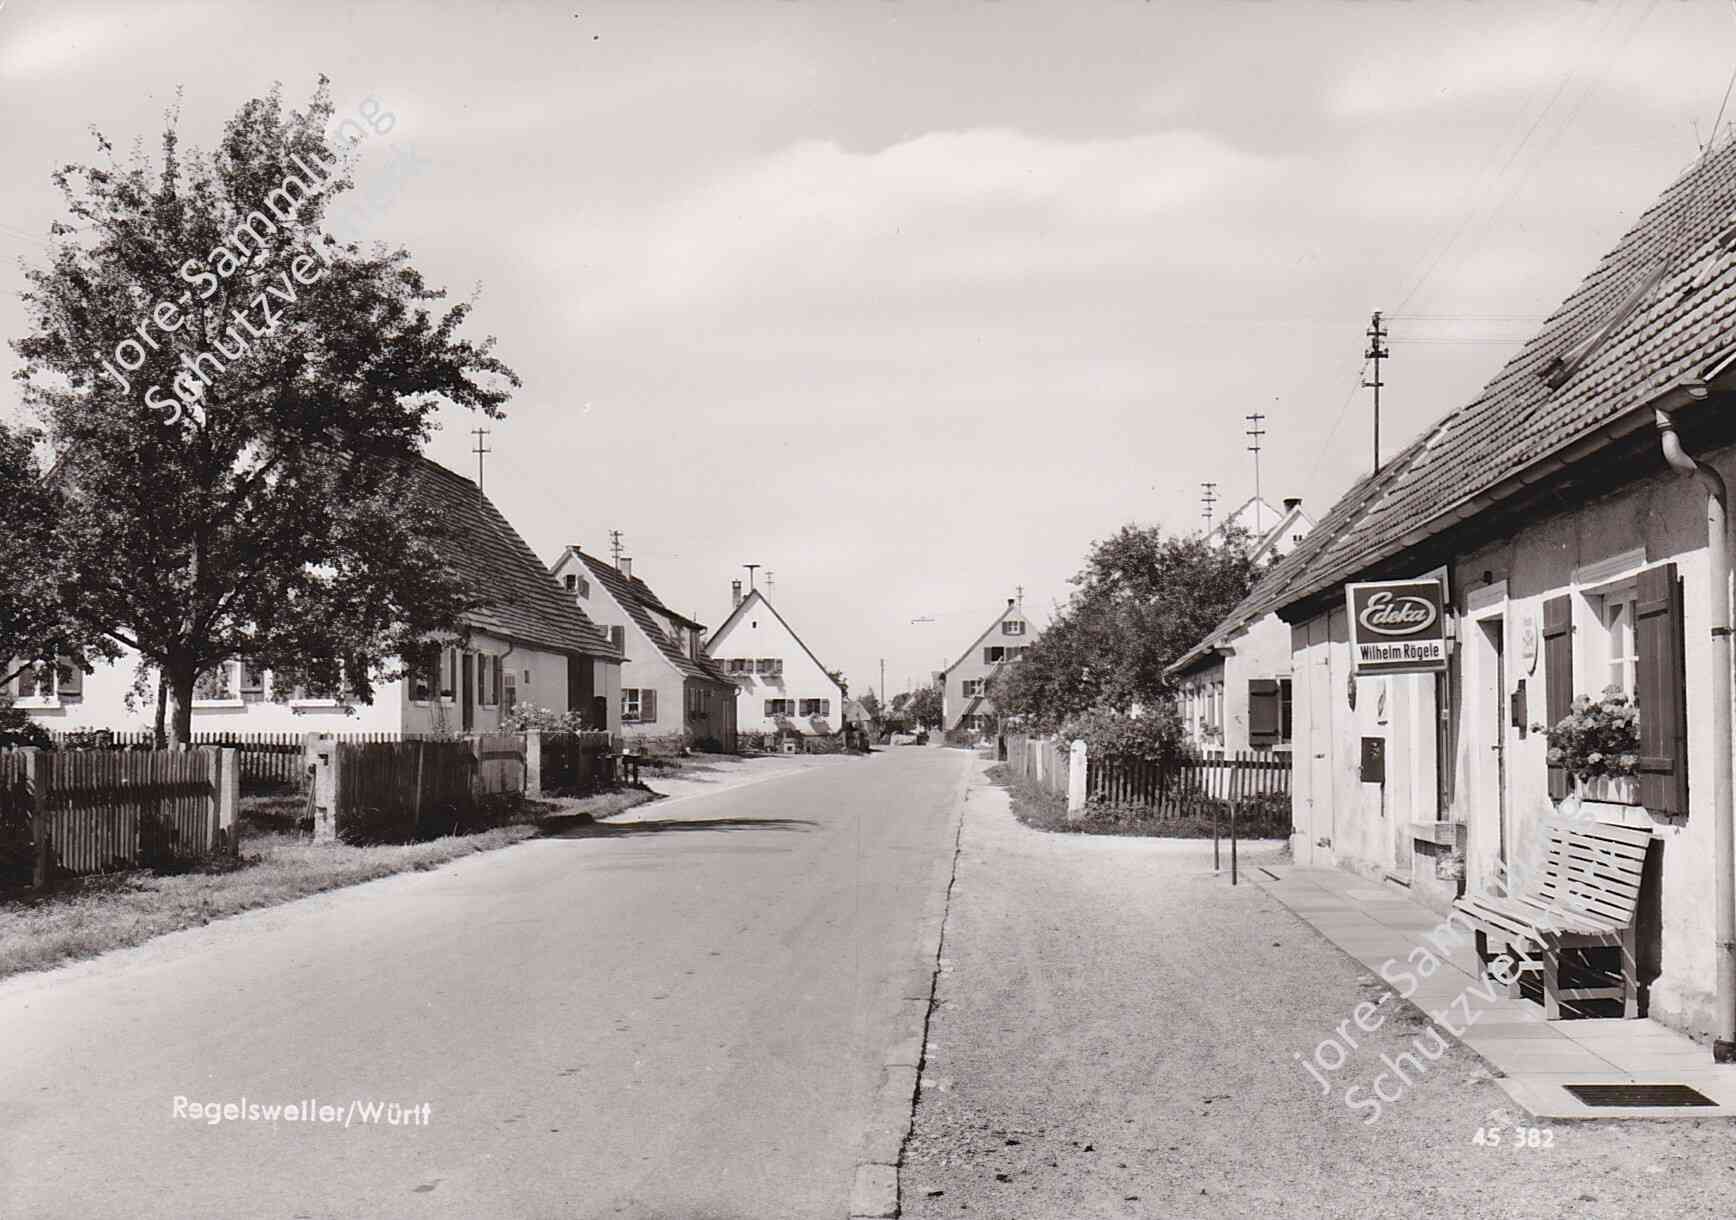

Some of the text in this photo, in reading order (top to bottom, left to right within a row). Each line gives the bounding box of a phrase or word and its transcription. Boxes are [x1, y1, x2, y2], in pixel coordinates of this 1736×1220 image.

[1360, 591, 1430, 626] Edeka
[1360, 643, 1440, 660] Wilhelm Rögele
